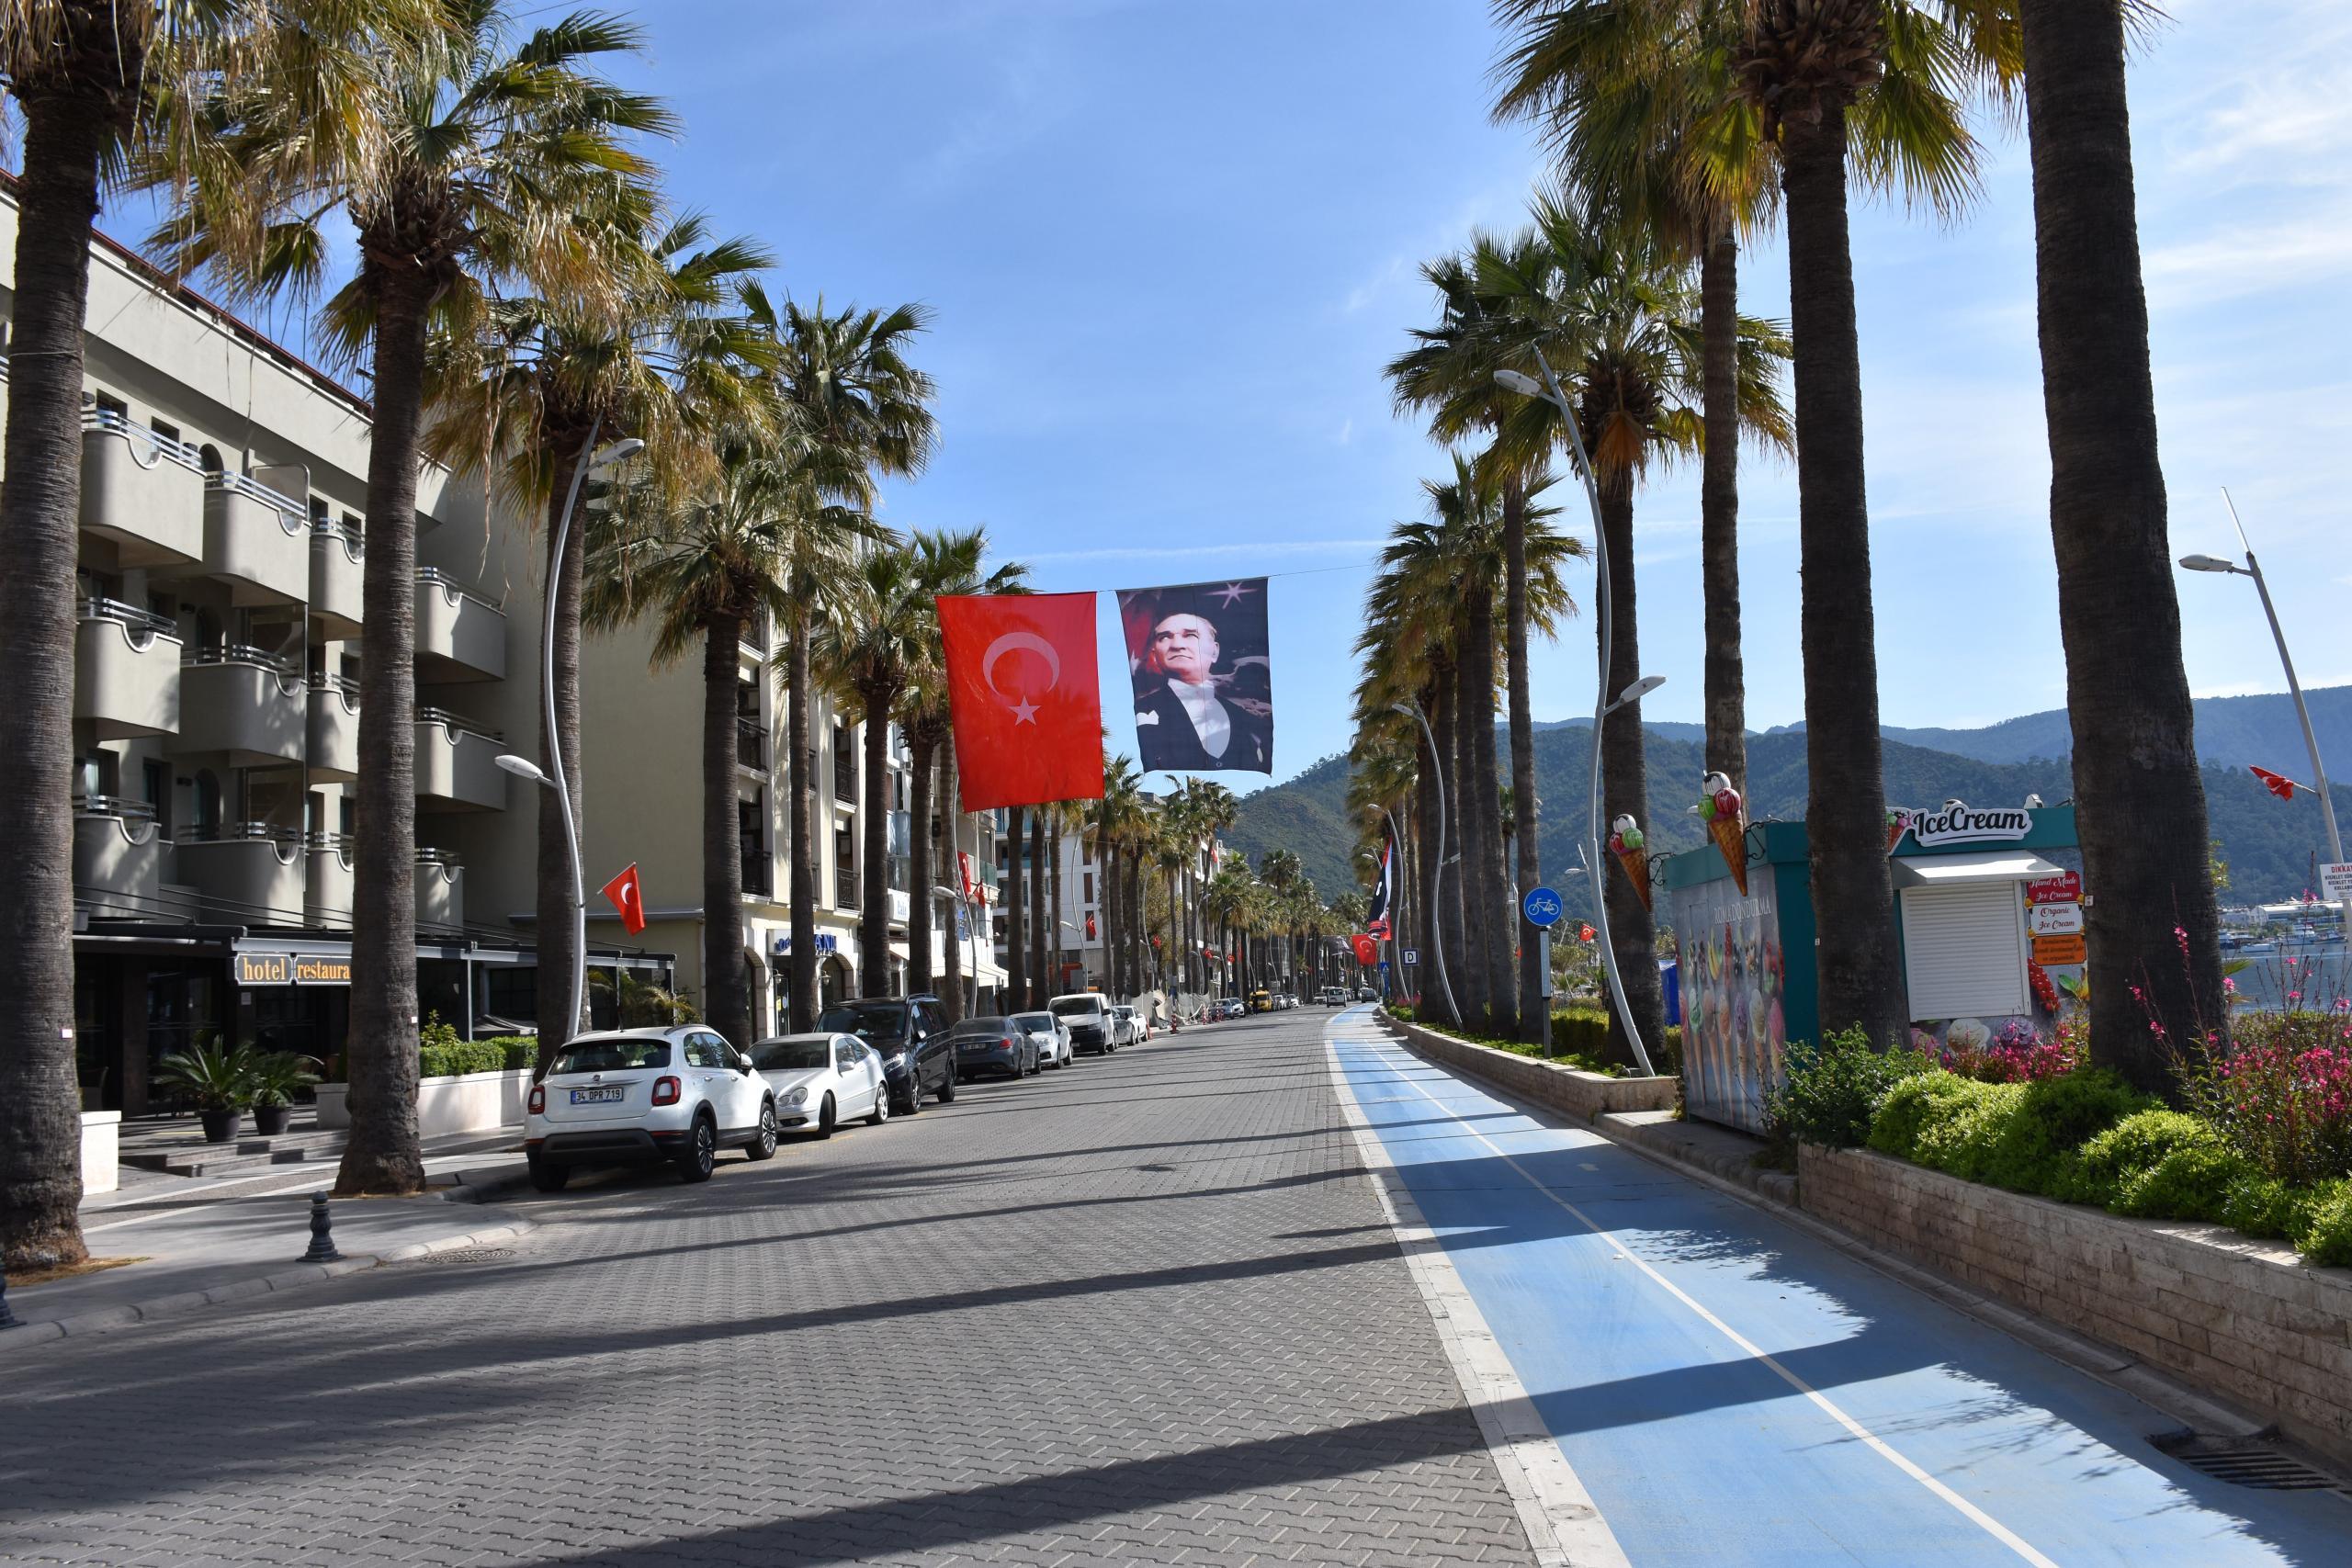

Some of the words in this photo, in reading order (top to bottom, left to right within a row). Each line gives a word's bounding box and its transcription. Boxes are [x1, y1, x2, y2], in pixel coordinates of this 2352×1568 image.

[1913, 807, 2028, 837] IceCream
[2030, 879, 2052, 888] Hand
[2053, 877, 2076, 888] Made
[2036, 892, 2048, 901] Ice
[2050, 891, 2073, 900] Cream
[2041, 908, 2070, 917] Organic
[2039, 921, 2051, 931] Ice
[2052, 920, 2075, 930] Cream
[1408, 953, 1414, 962] D
[243, 957, 286, 980] hotel
[298, 960, 351, 980] restaura
[576, 1092, 585, 1101] 34
[589, 1090, 604, 1100] DPR
[605, 1089, 620, 1100] 719
